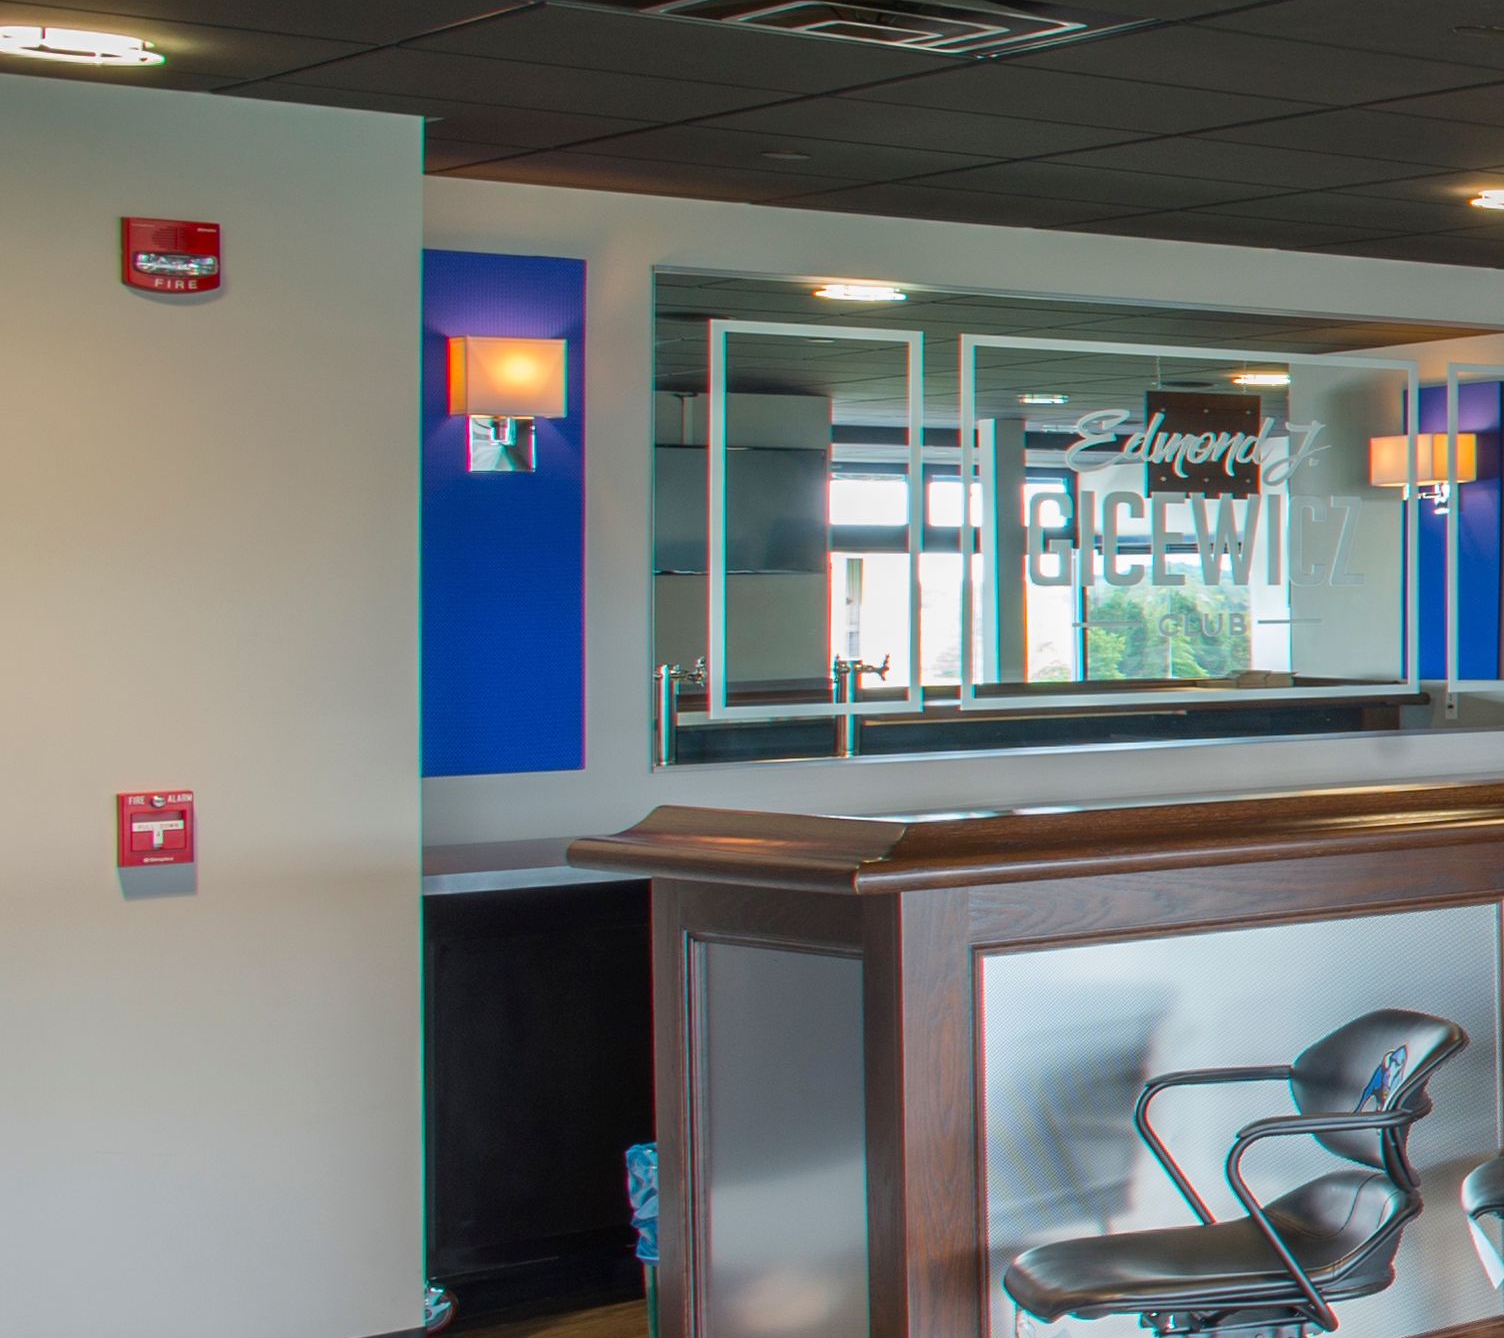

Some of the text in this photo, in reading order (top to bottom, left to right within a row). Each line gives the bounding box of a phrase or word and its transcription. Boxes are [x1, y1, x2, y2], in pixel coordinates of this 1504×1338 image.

[154, 278, 198, 290] FIRE
[1065, 409, 1275, 477] Edmond
[1028, 490, 1364, 587] GICEWICZ
[1159, 612, 1249, 637] CLUB
